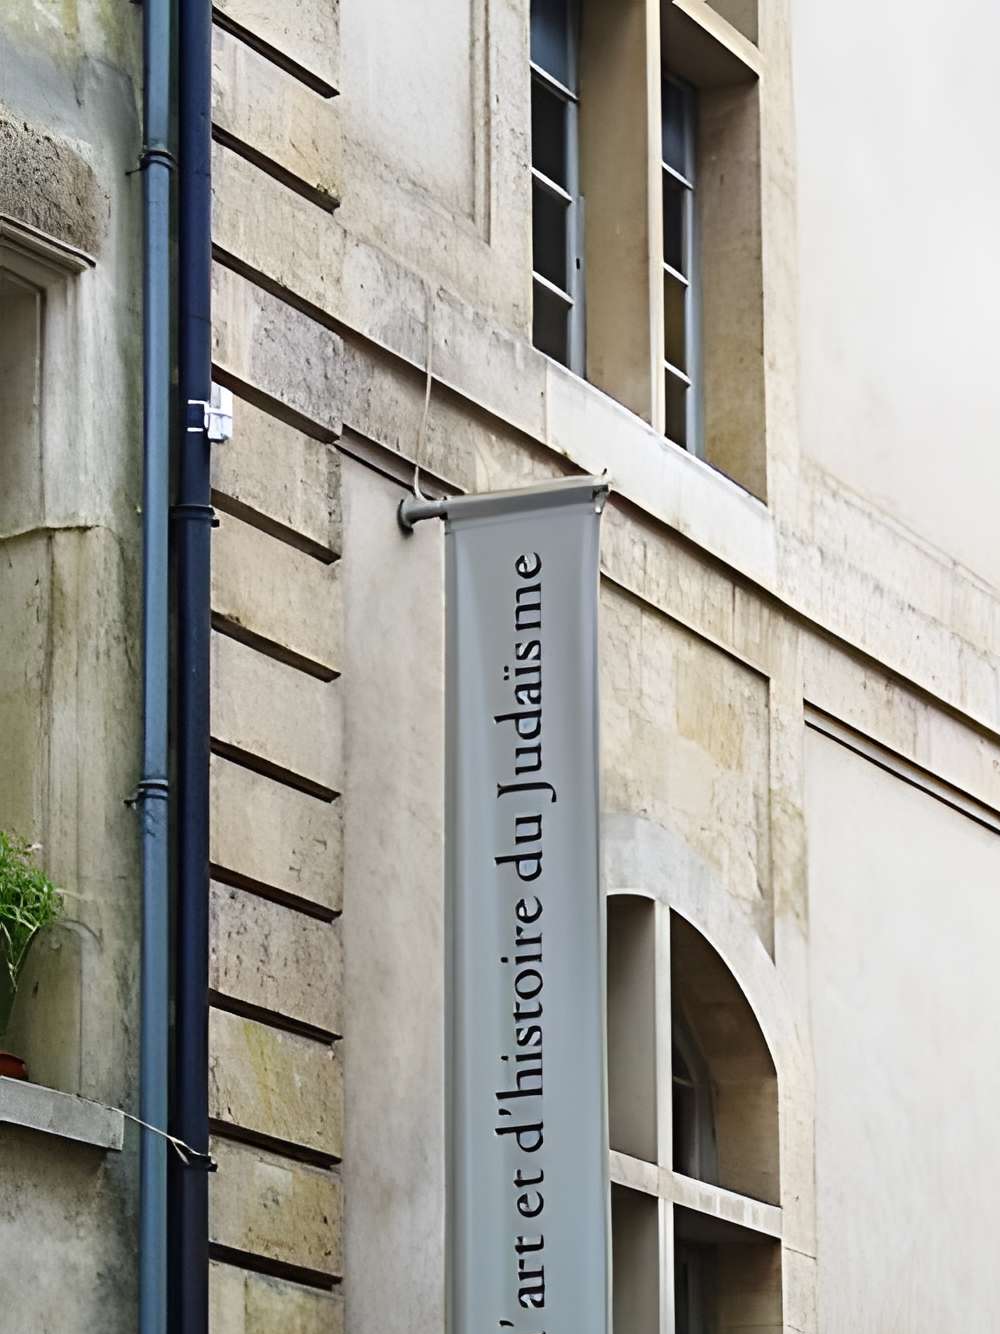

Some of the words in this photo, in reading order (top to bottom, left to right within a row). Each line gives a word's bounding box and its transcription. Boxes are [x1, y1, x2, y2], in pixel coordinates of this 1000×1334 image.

[493, 552, 557, 803] Judaïsme
[494, 813, 543, 882] du
[494, 896, 544, 1153] d'histoire
[513, 1169, 545, 1218] et
